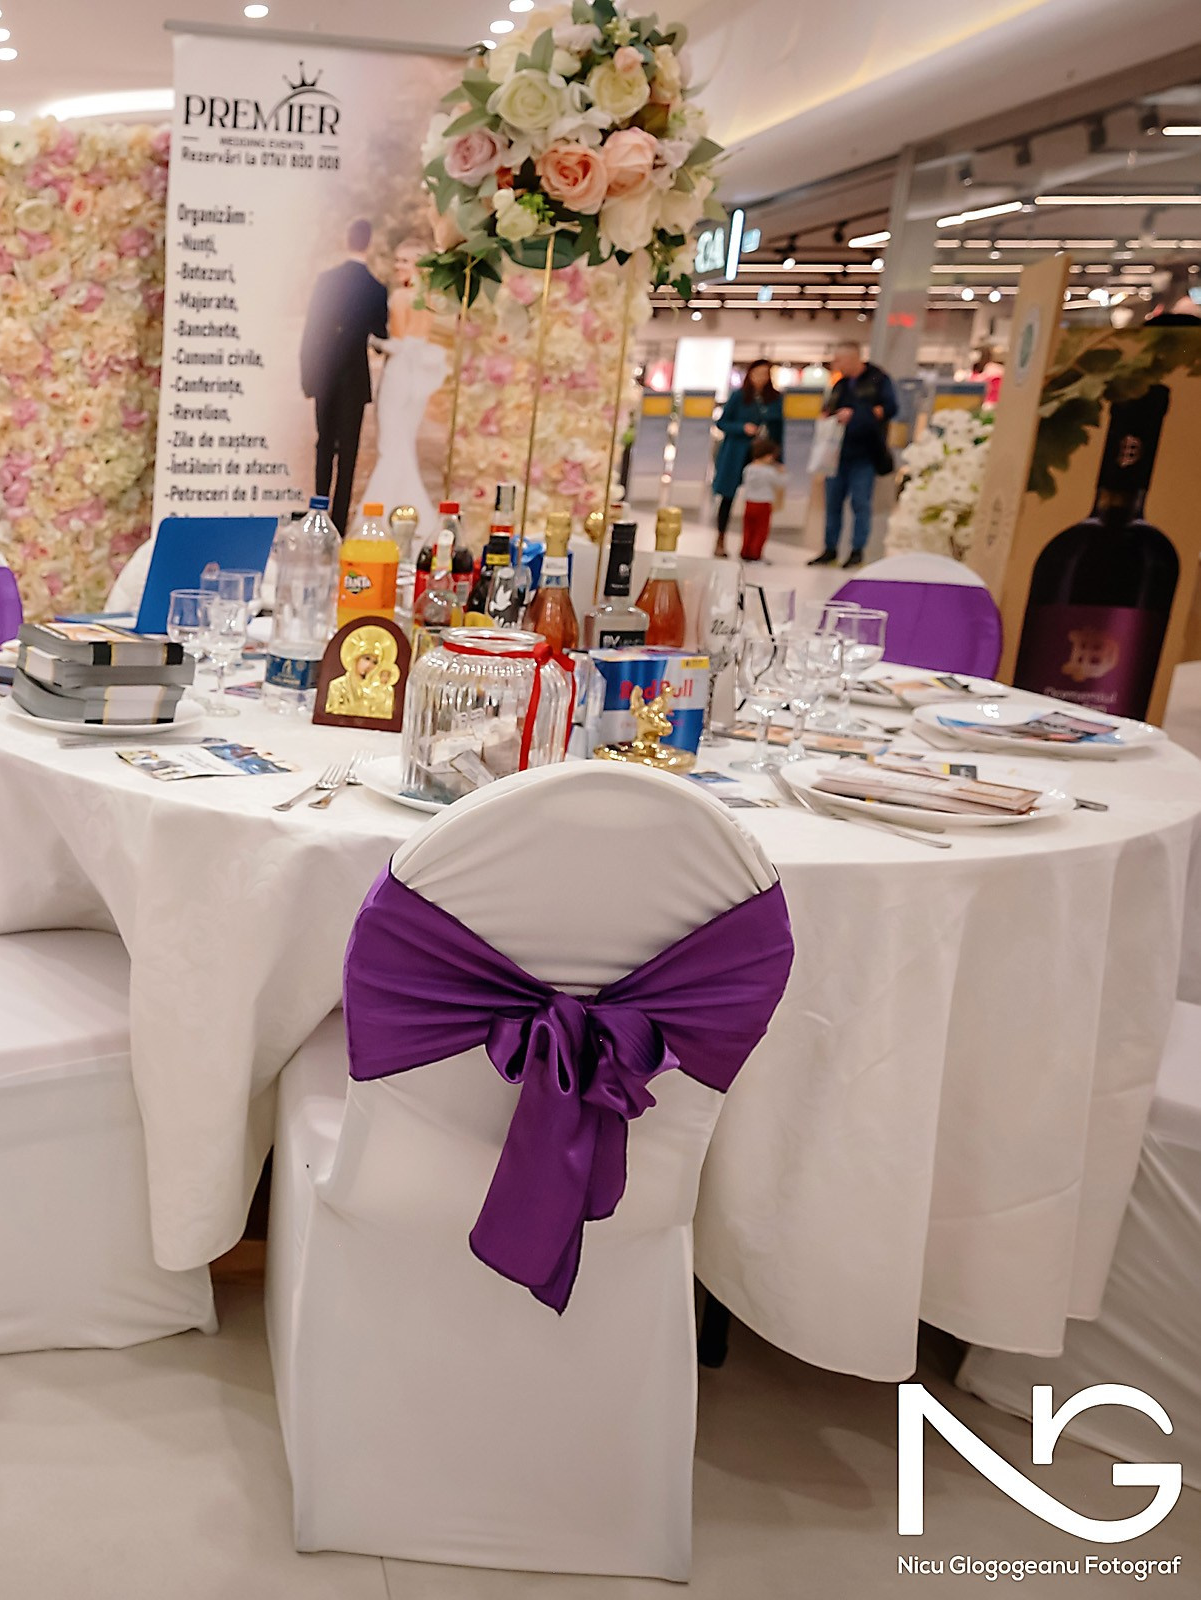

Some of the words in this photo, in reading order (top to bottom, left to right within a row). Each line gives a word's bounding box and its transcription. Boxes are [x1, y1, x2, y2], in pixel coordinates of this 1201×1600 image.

[184, 94, 340, 135] PREMIER
[269, 139, 304, 149] EVENTS
[246, 153, 256, 165] la
[199, 433, 213, 448] de
[226, 459, 240, 475] de
[232, 485, 246, 501] de
[343, 575, 372, 589] FANTA
[620, 679, 657, 699] Rd
